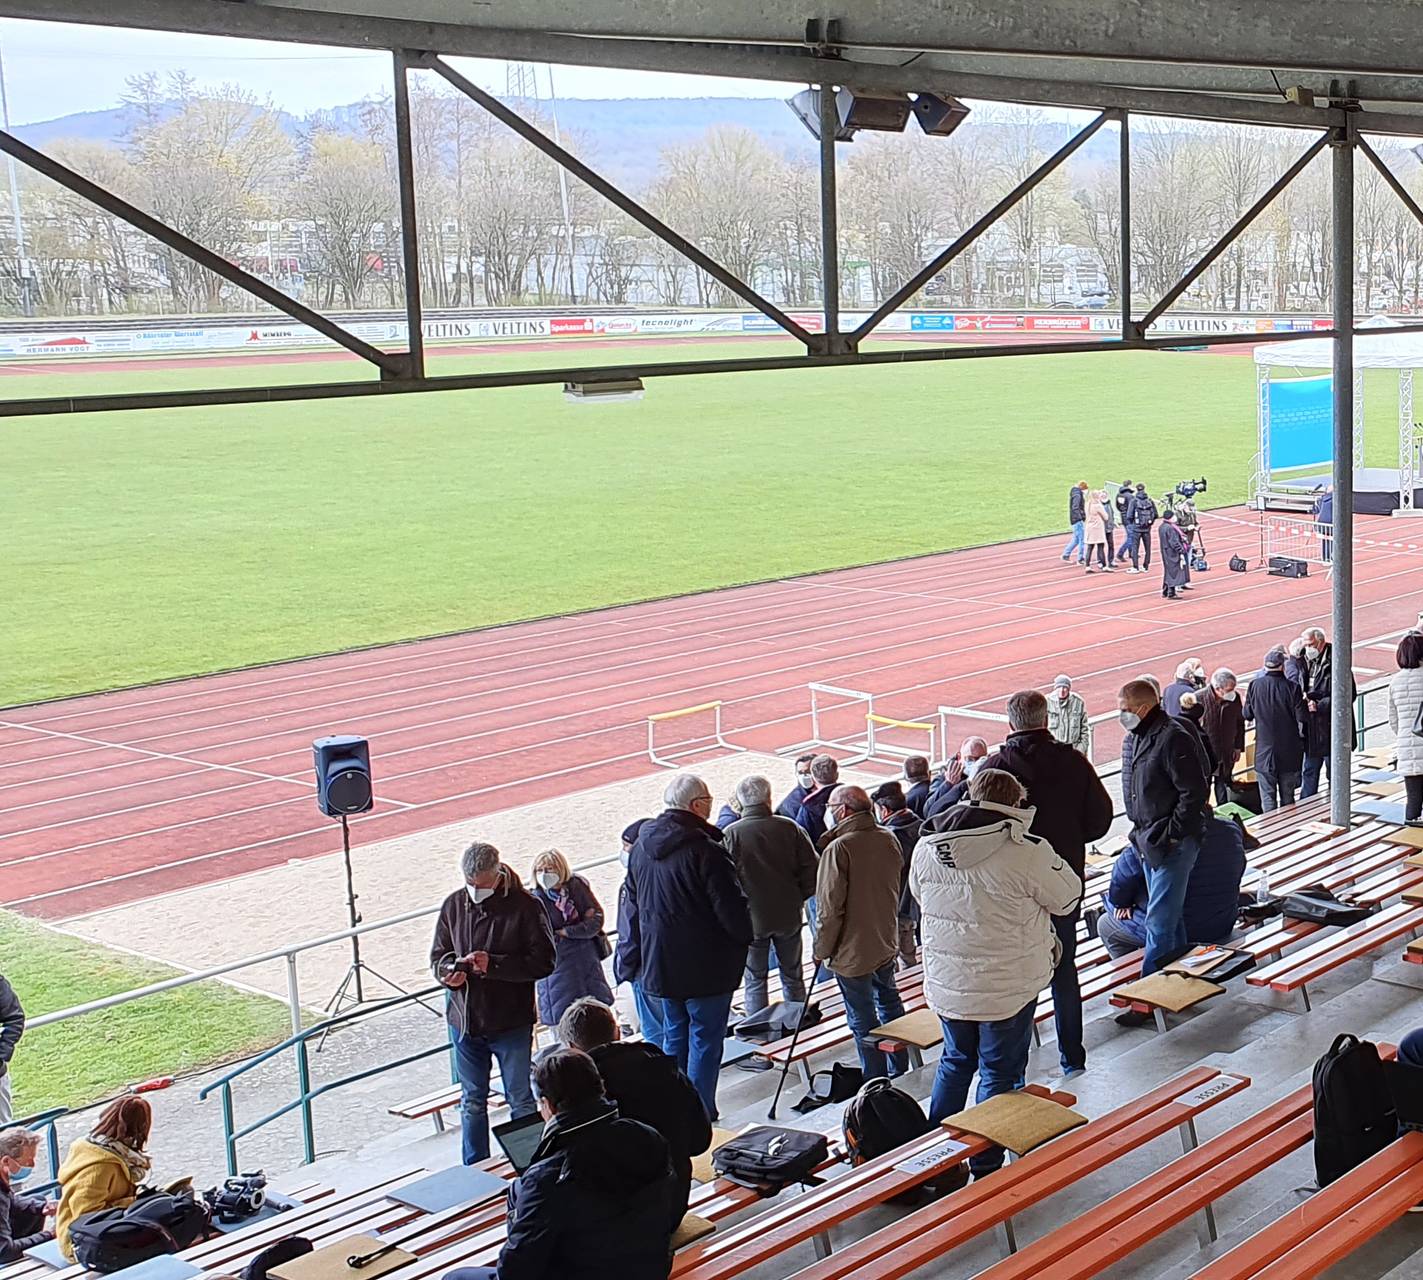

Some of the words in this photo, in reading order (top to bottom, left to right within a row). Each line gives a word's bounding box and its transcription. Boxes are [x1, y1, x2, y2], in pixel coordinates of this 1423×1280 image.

[492, 321, 545, 335] VELTINS
[1178, 320, 1227, 331] VELTINS
[937, 842, 956, 869] CMP
[914, 1147, 955, 1168] PRESSE
